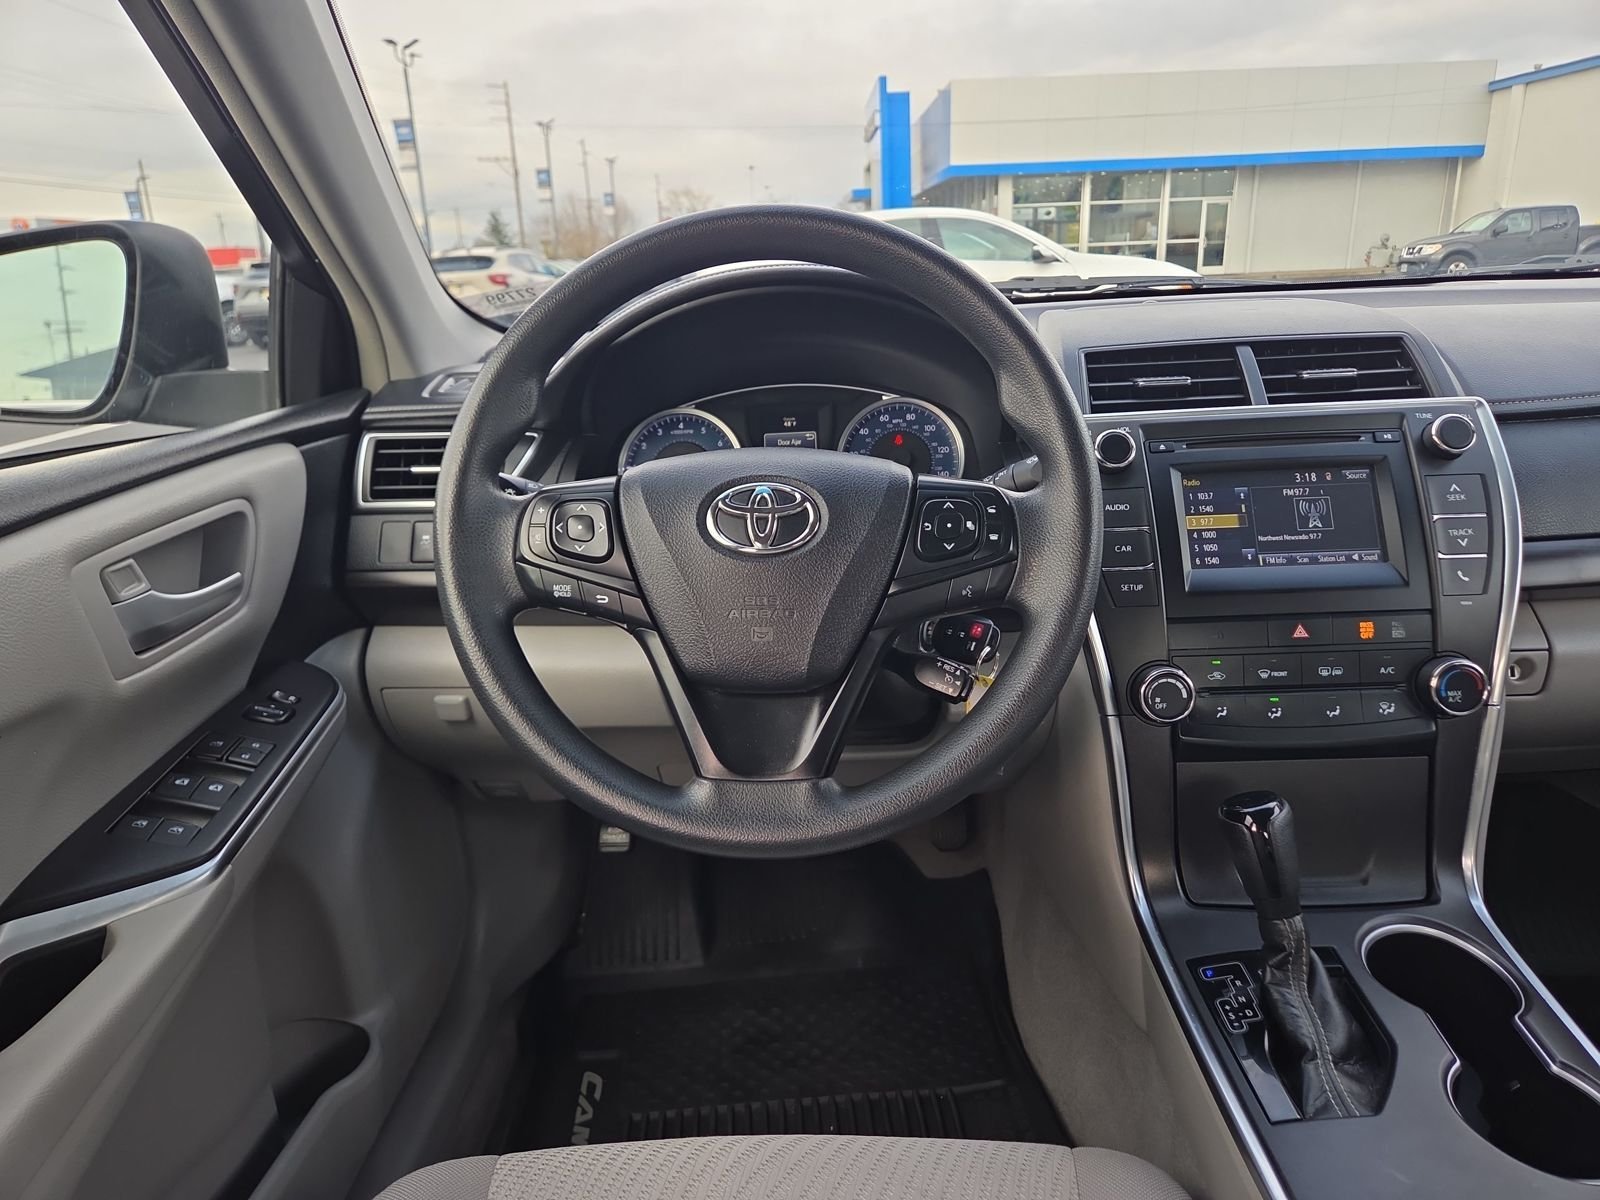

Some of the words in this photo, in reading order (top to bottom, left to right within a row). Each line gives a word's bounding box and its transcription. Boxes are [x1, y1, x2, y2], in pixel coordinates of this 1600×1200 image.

[879, 414, 889, 422] 60
[905, 413, 915, 421] 80
[657, 428, 663, 436] 3
[937, 446, 950, 454] 120
[1294, 472, 1317, 482] 3:18
[1345, 471, 1367, 480] Source
[1197, 492, 1213, 500] 103.7
[1446, 493, 1466, 501] SEEK
[1105, 503, 1130, 511] AUDIO
[1199, 505, 1214, 513] 1540
[1191, 518, 1196, 526] 3
[1200, 518, 1214, 526] 97.7
[1201, 531, 1217, 539] 1000
[1448, 528, 1475, 536] TRACK
[1195, 557, 1200, 565] 6
[1204, 557, 1220, 565] 1540
[1318, 554, 1336, 562] Station
[1336, 554, 1346, 562] List
[1362, 553, 1378, 561] Sound
[553, 584, 572, 592] MODE
[1120, 583, 1144, 591] SETUP
[942, 663, 956, 673] RES
[1379, 666, 1395, 674] A/C
[1228, 1012, 1236, 1020] S
[1245, 1009, 1254, 1017] D
